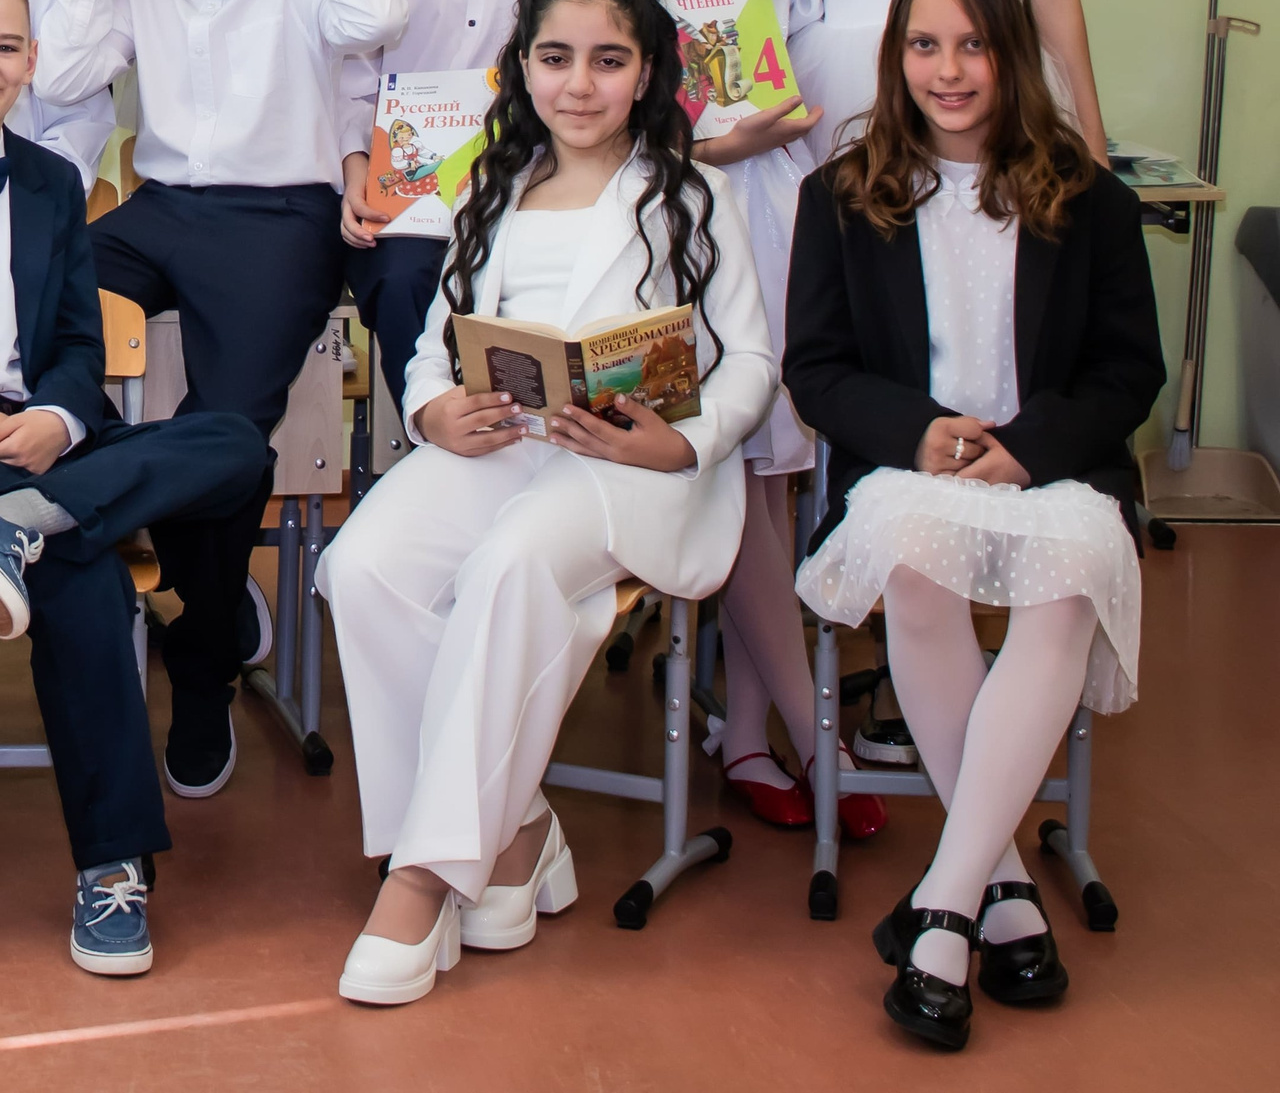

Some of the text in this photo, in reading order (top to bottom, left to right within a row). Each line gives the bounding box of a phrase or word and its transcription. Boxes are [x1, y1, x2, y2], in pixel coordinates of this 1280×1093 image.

[753, 37, 787, 90] 4
[384, 99, 460, 117] Русский
[589, 328, 638, 348] НОВЕЙШАЯ
[589, 318, 690, 358] ХРЕСТОМАТИЯ
[592, 362, 599, 372] 3
[599, 355, 633, 371] класс
